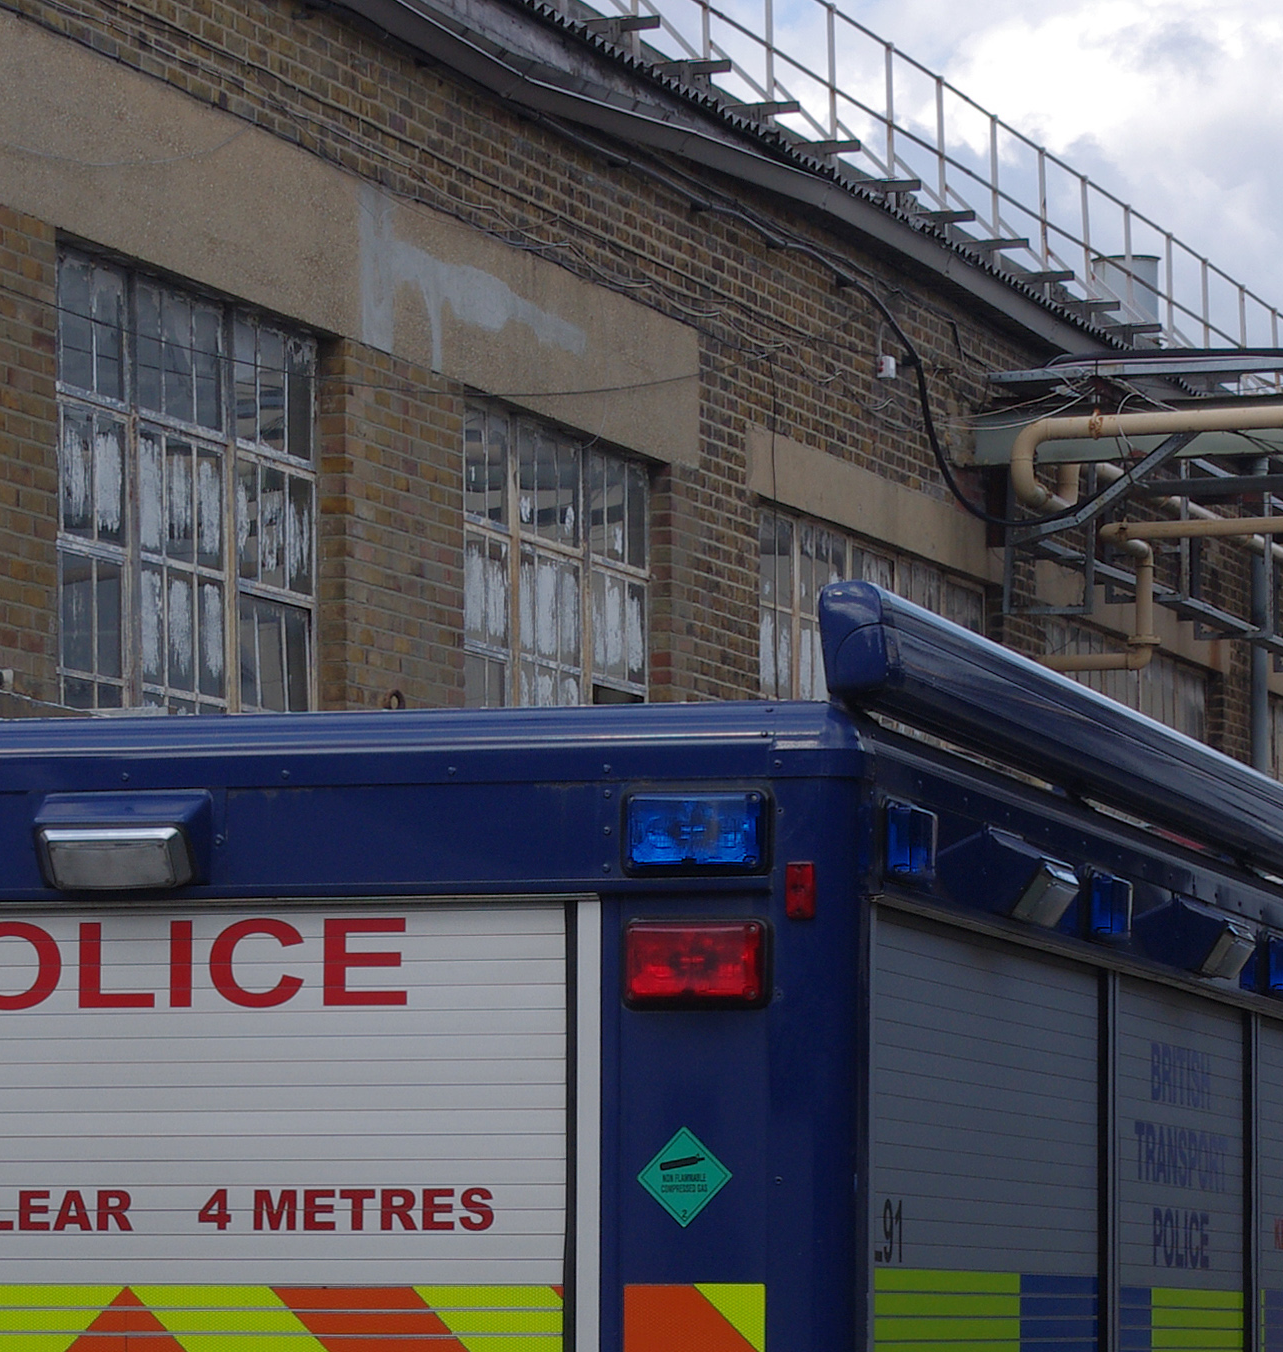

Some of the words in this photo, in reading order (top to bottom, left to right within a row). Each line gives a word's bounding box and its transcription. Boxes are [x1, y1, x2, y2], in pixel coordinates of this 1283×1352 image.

[1150, 1042, 1211, 1110] BRITISH
[1134, 1119, 1228, 1192] TRANSPORT
[198, 1188, 232, 1232] 4
[253, 1188, 496, 1232] METRES
[875, 1198, 903, 1263] 91
[1153, 1207, 1210, 1269] POLICE
